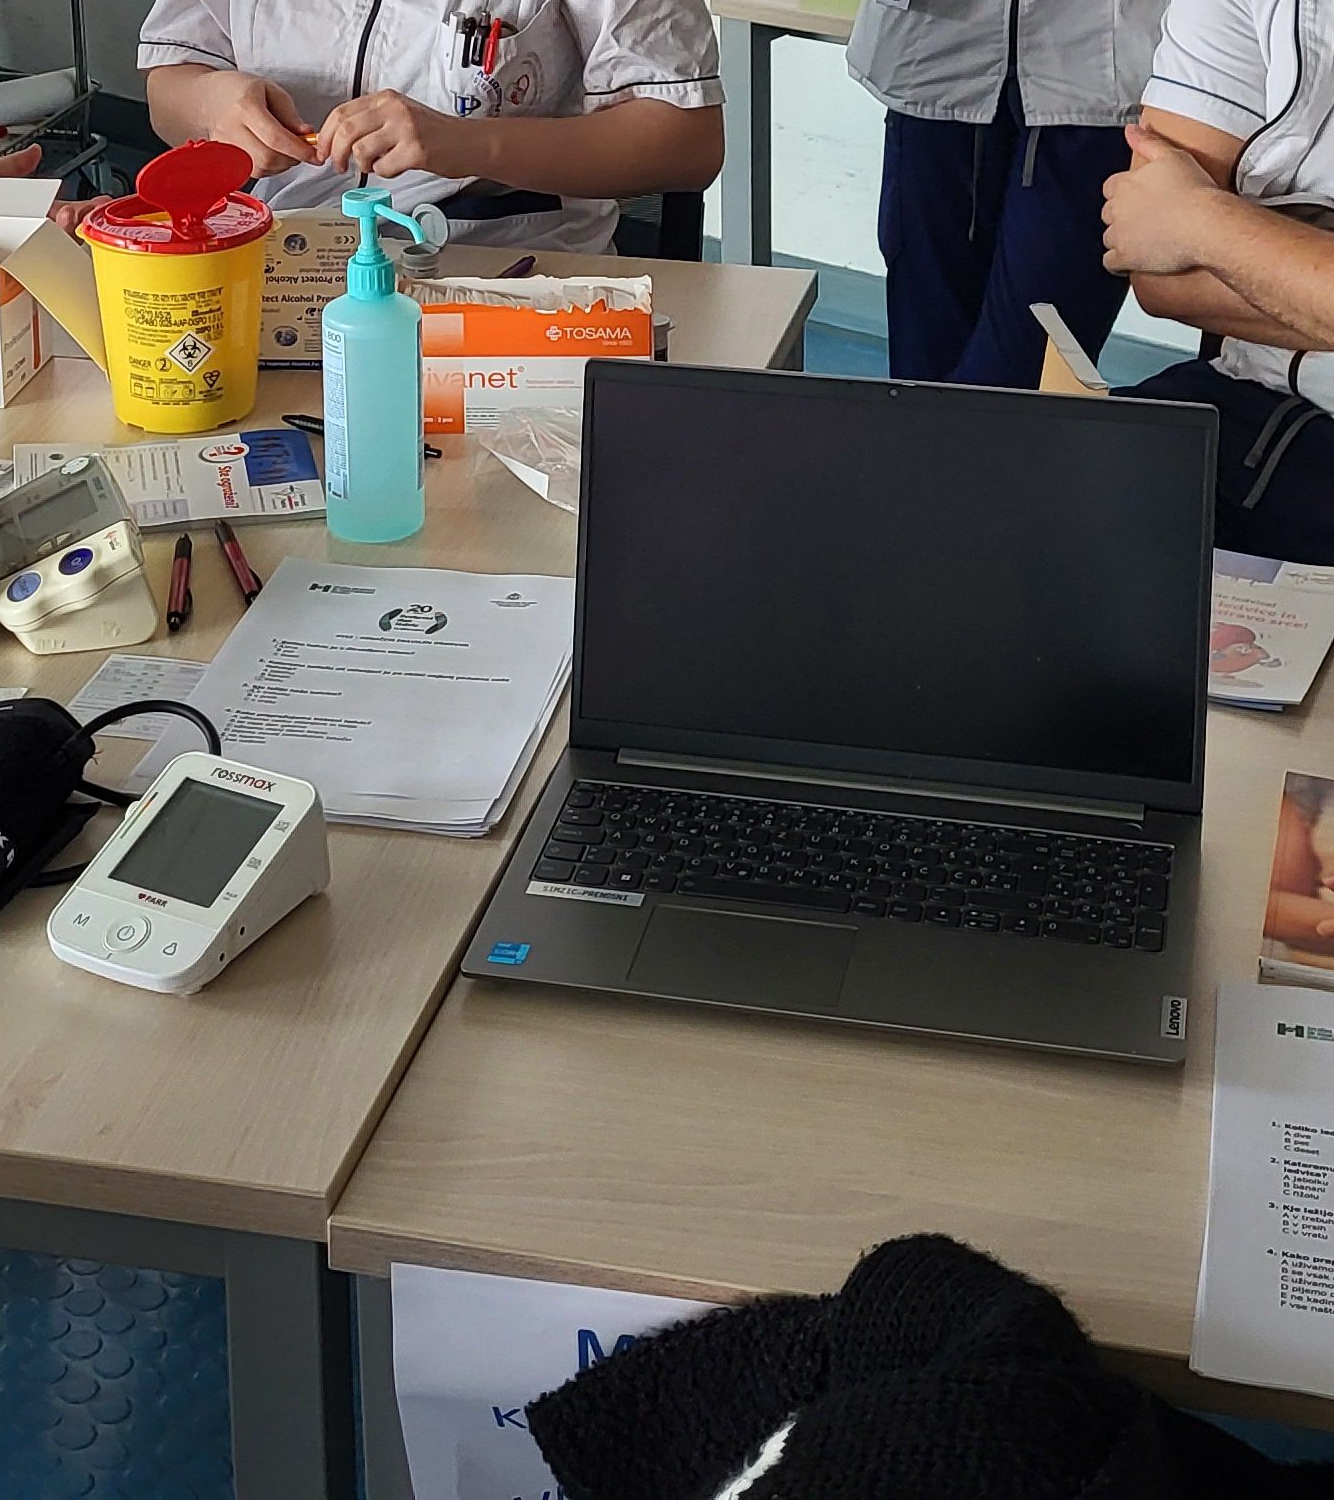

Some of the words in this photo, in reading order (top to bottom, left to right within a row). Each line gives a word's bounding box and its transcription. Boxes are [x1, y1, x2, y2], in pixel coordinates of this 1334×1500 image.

[564, 327, 632, 340] TOSAMA
[211, 768, 276, 792] rossmax
[72, 914, 90, 926] M
[1166, 1000, 1181, 1036] Lenovo
